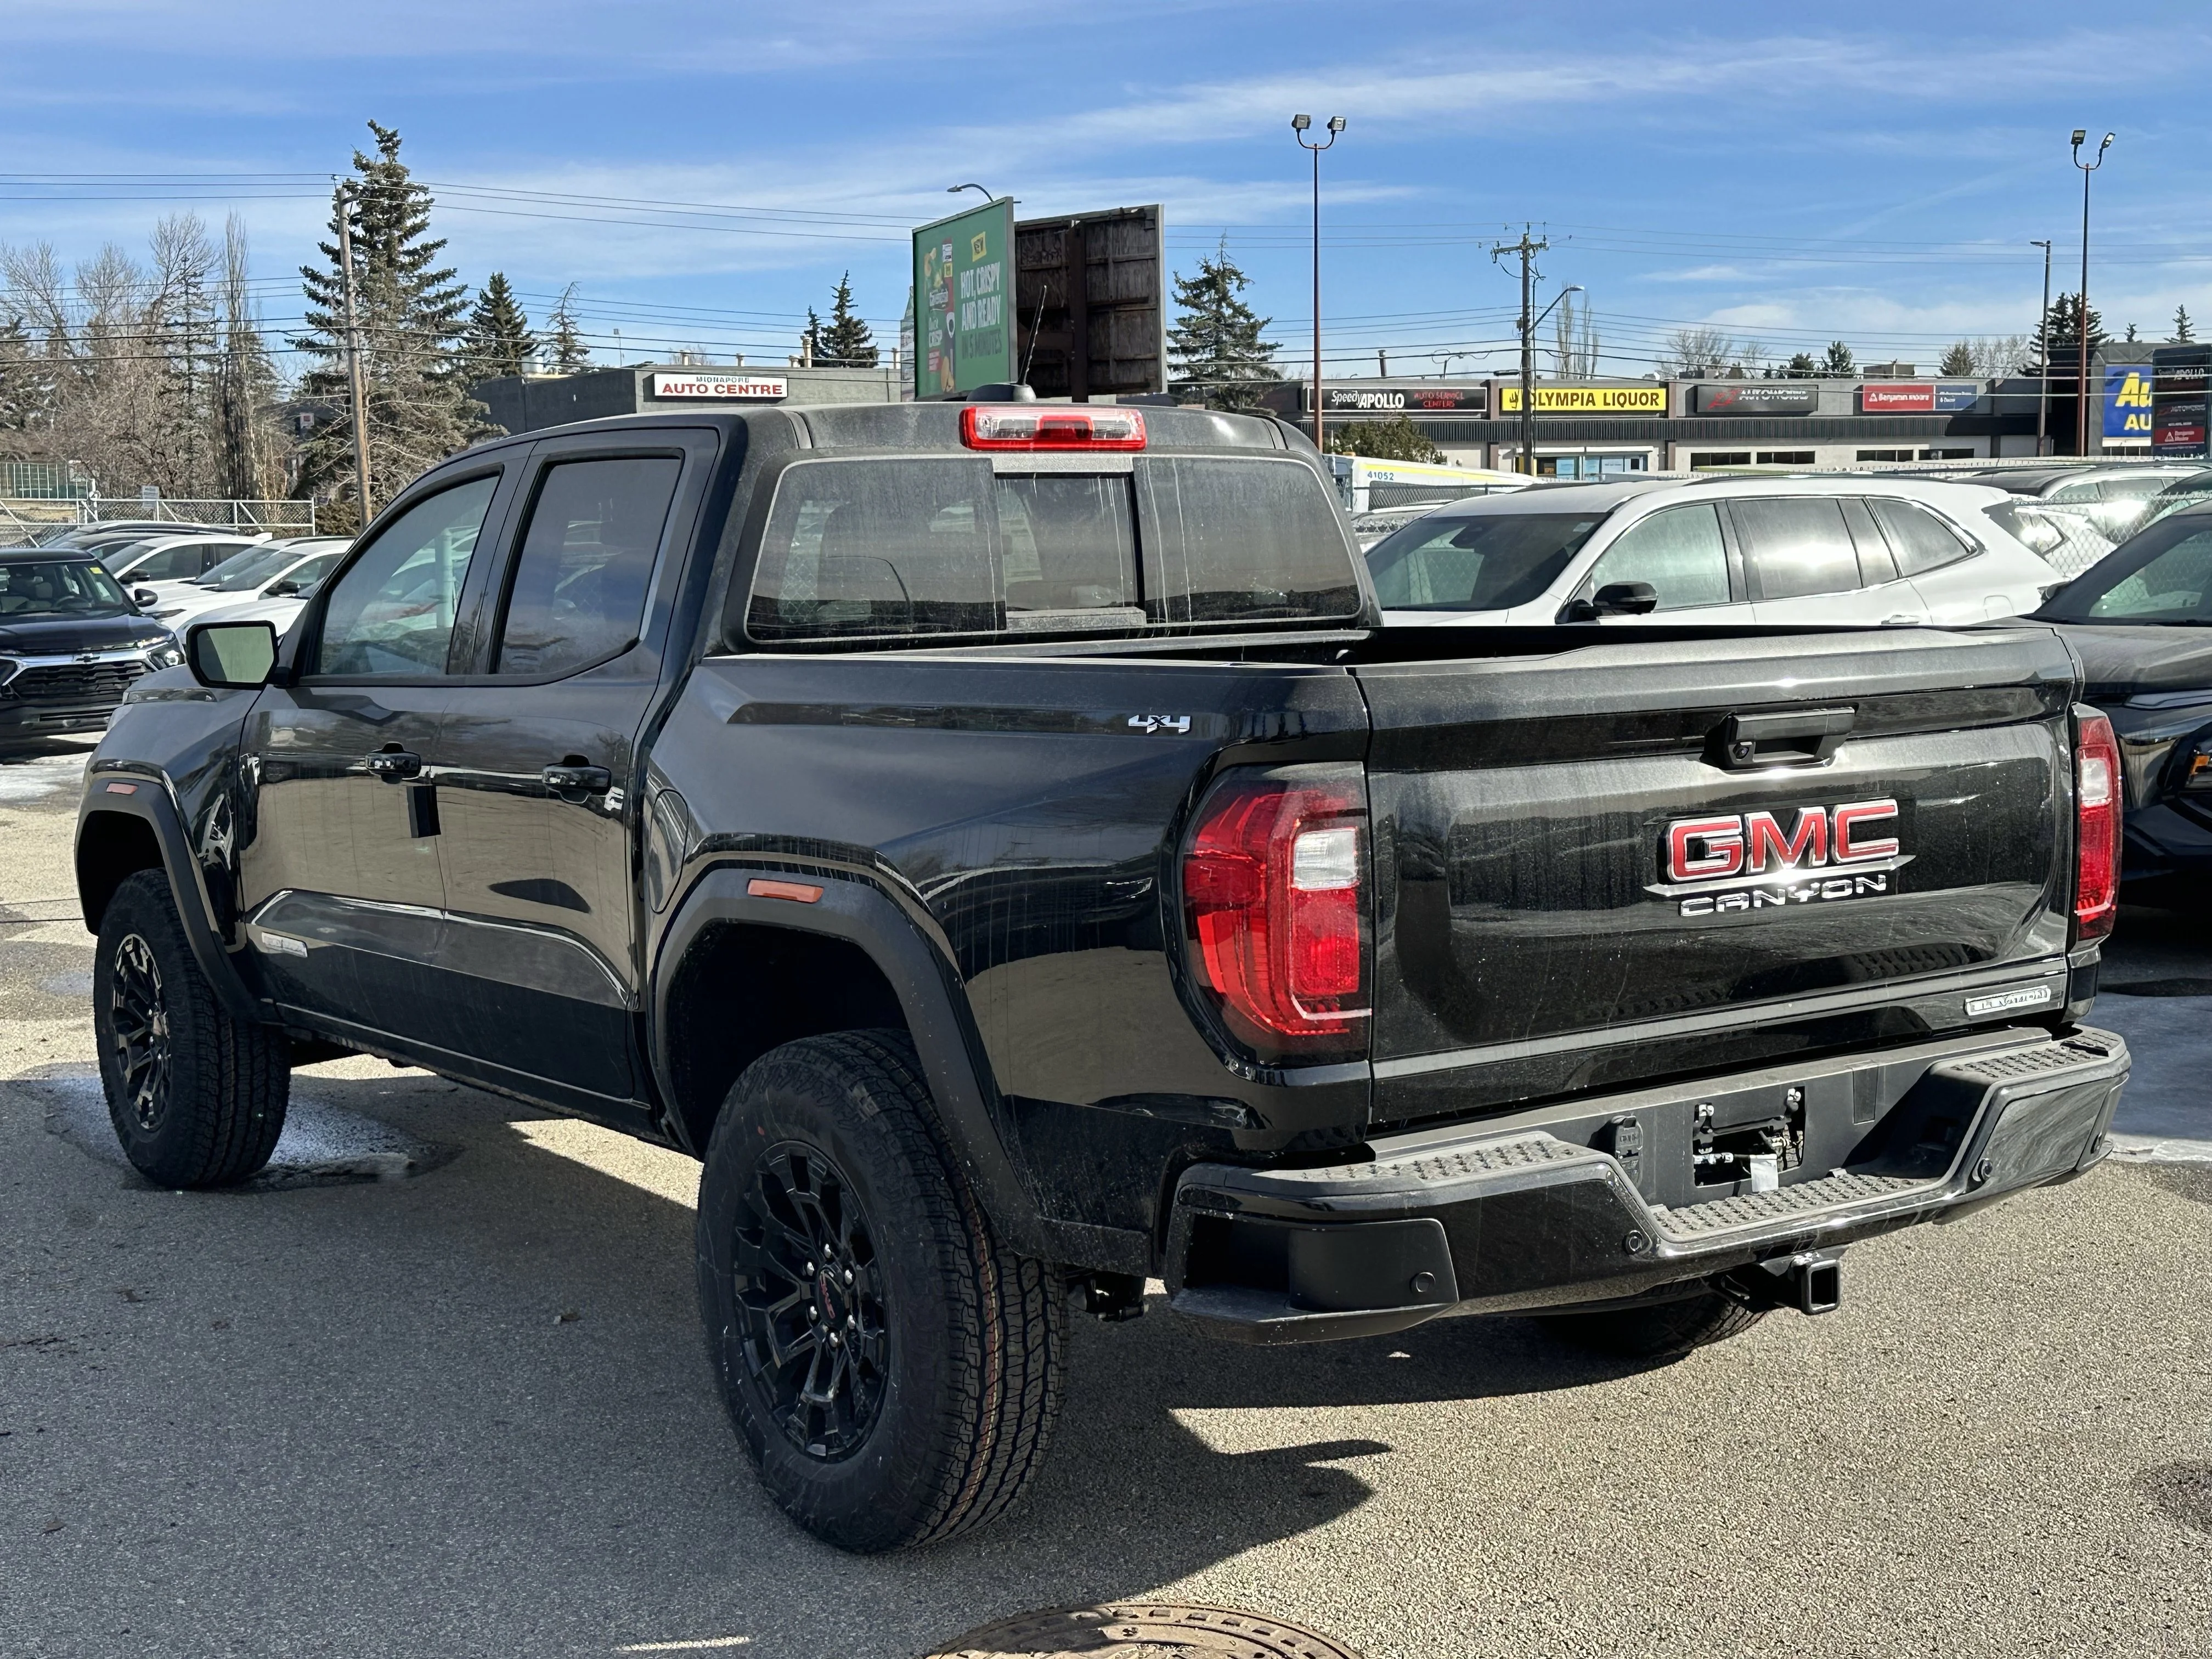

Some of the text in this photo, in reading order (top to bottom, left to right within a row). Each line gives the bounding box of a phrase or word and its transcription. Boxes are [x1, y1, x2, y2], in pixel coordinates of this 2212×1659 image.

[977, 261, 1000, 295] CRISPY
[962, 301, 977, 331] AND
[978, 295, 1001, 328] READY
[662, 383, 783, 394] AUTO CENTRE
[1358, 393, 1405, 409] APOLLO
[1603, 392, 1660, 408] LIQUOR
[1367, 471, 1394, 481] 41052
[1667, 799, 1899, 882] GMC
[1679, 874, 1886, 917] CANYON
